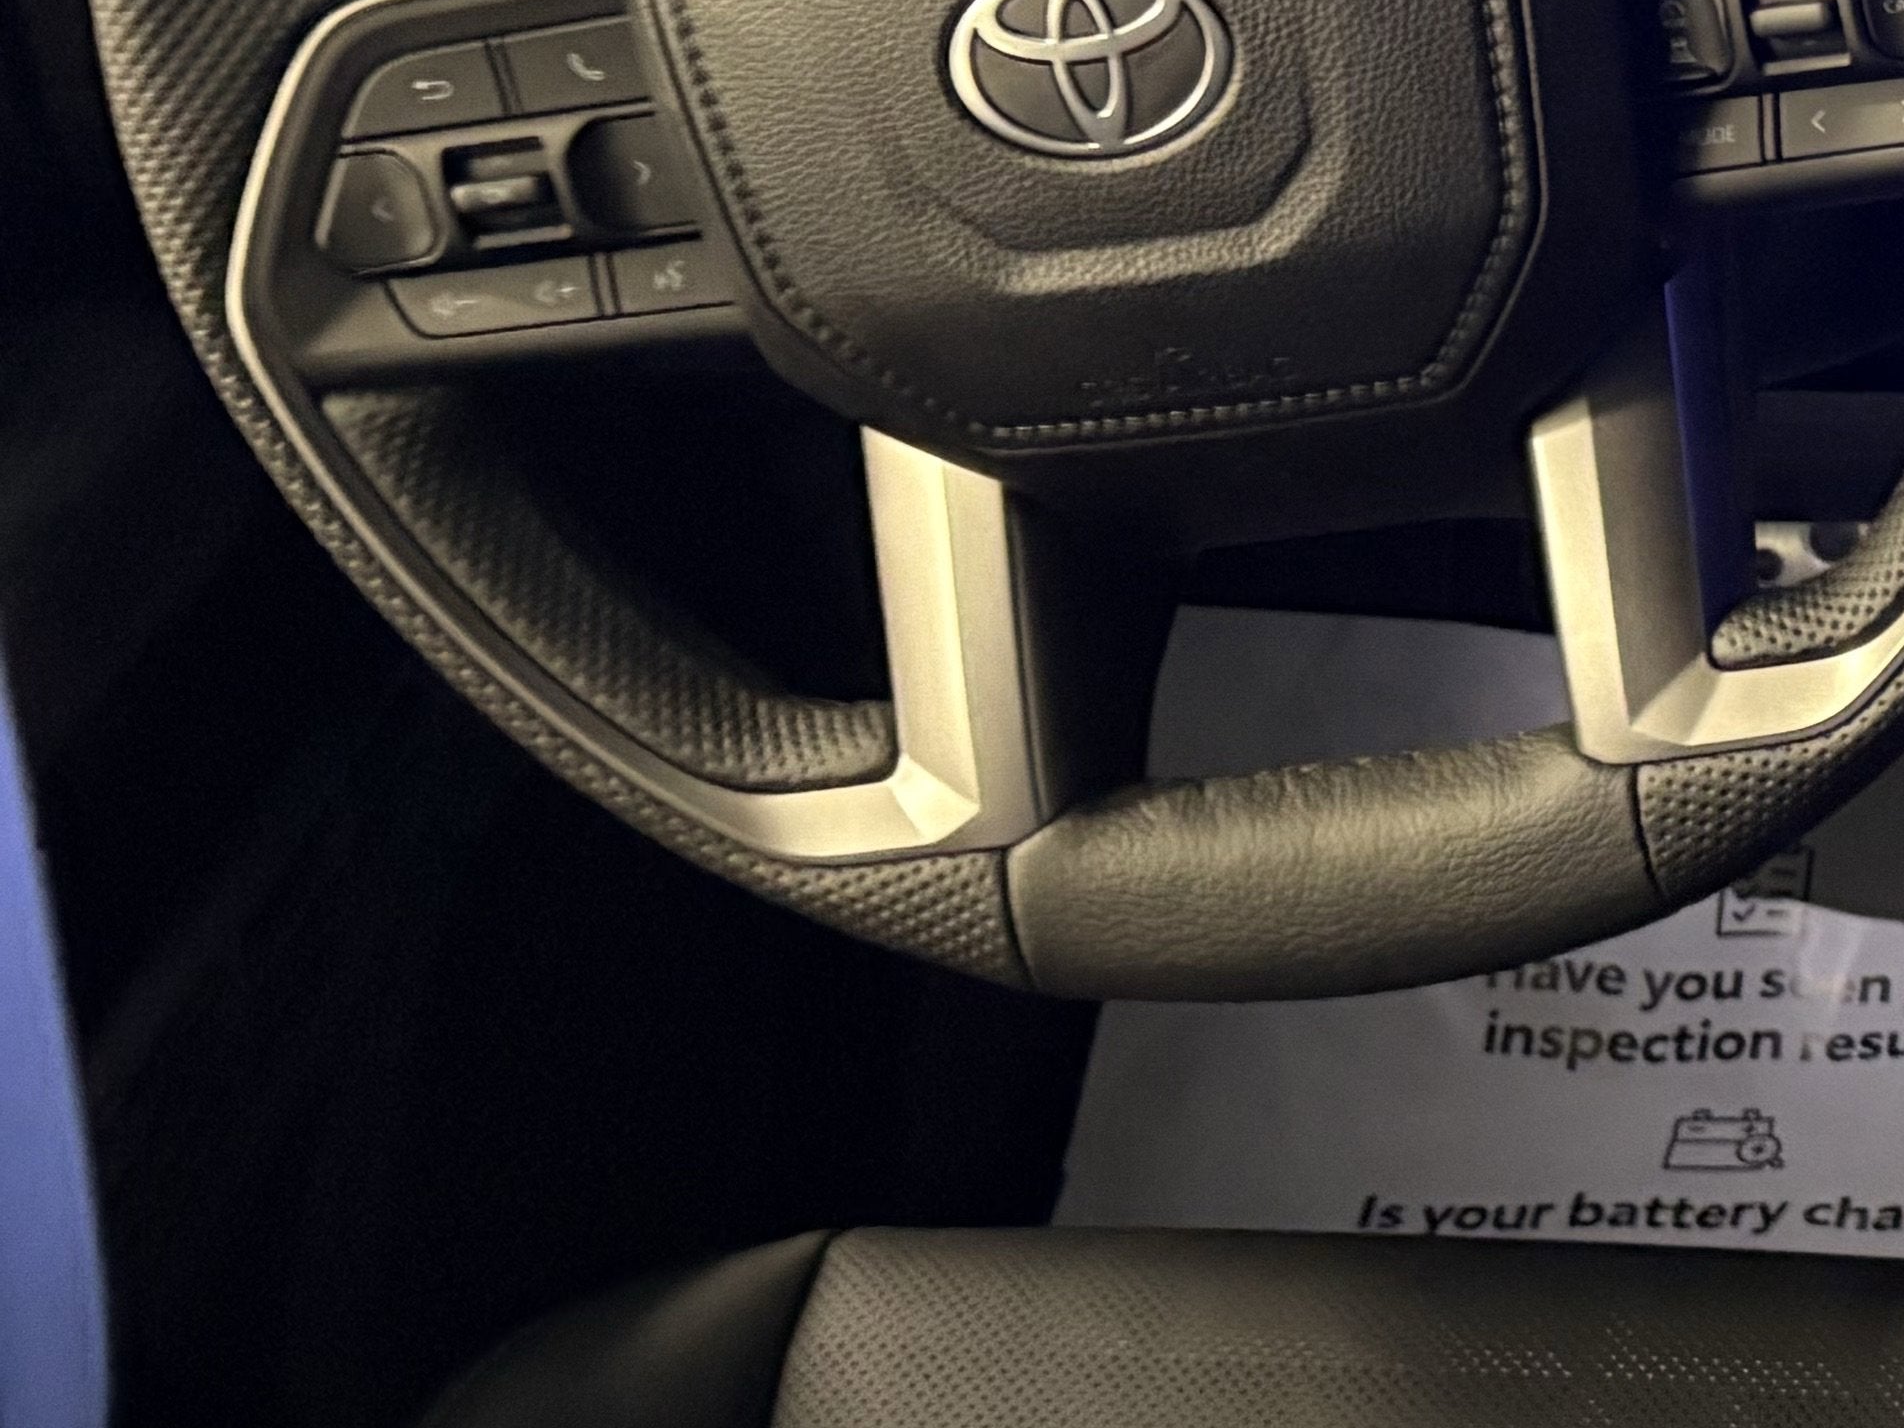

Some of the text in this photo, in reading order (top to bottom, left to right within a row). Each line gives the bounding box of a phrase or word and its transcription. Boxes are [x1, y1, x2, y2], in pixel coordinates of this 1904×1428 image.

[1640, 968, 1743, 1011] you
[1483, 1010, 1784, 1072] inspection
[1357, 1194, 1403, 1230] Is
[1422, 1196, 1553, 1236] your
[1567, 1192, 1789, 1234] battery
